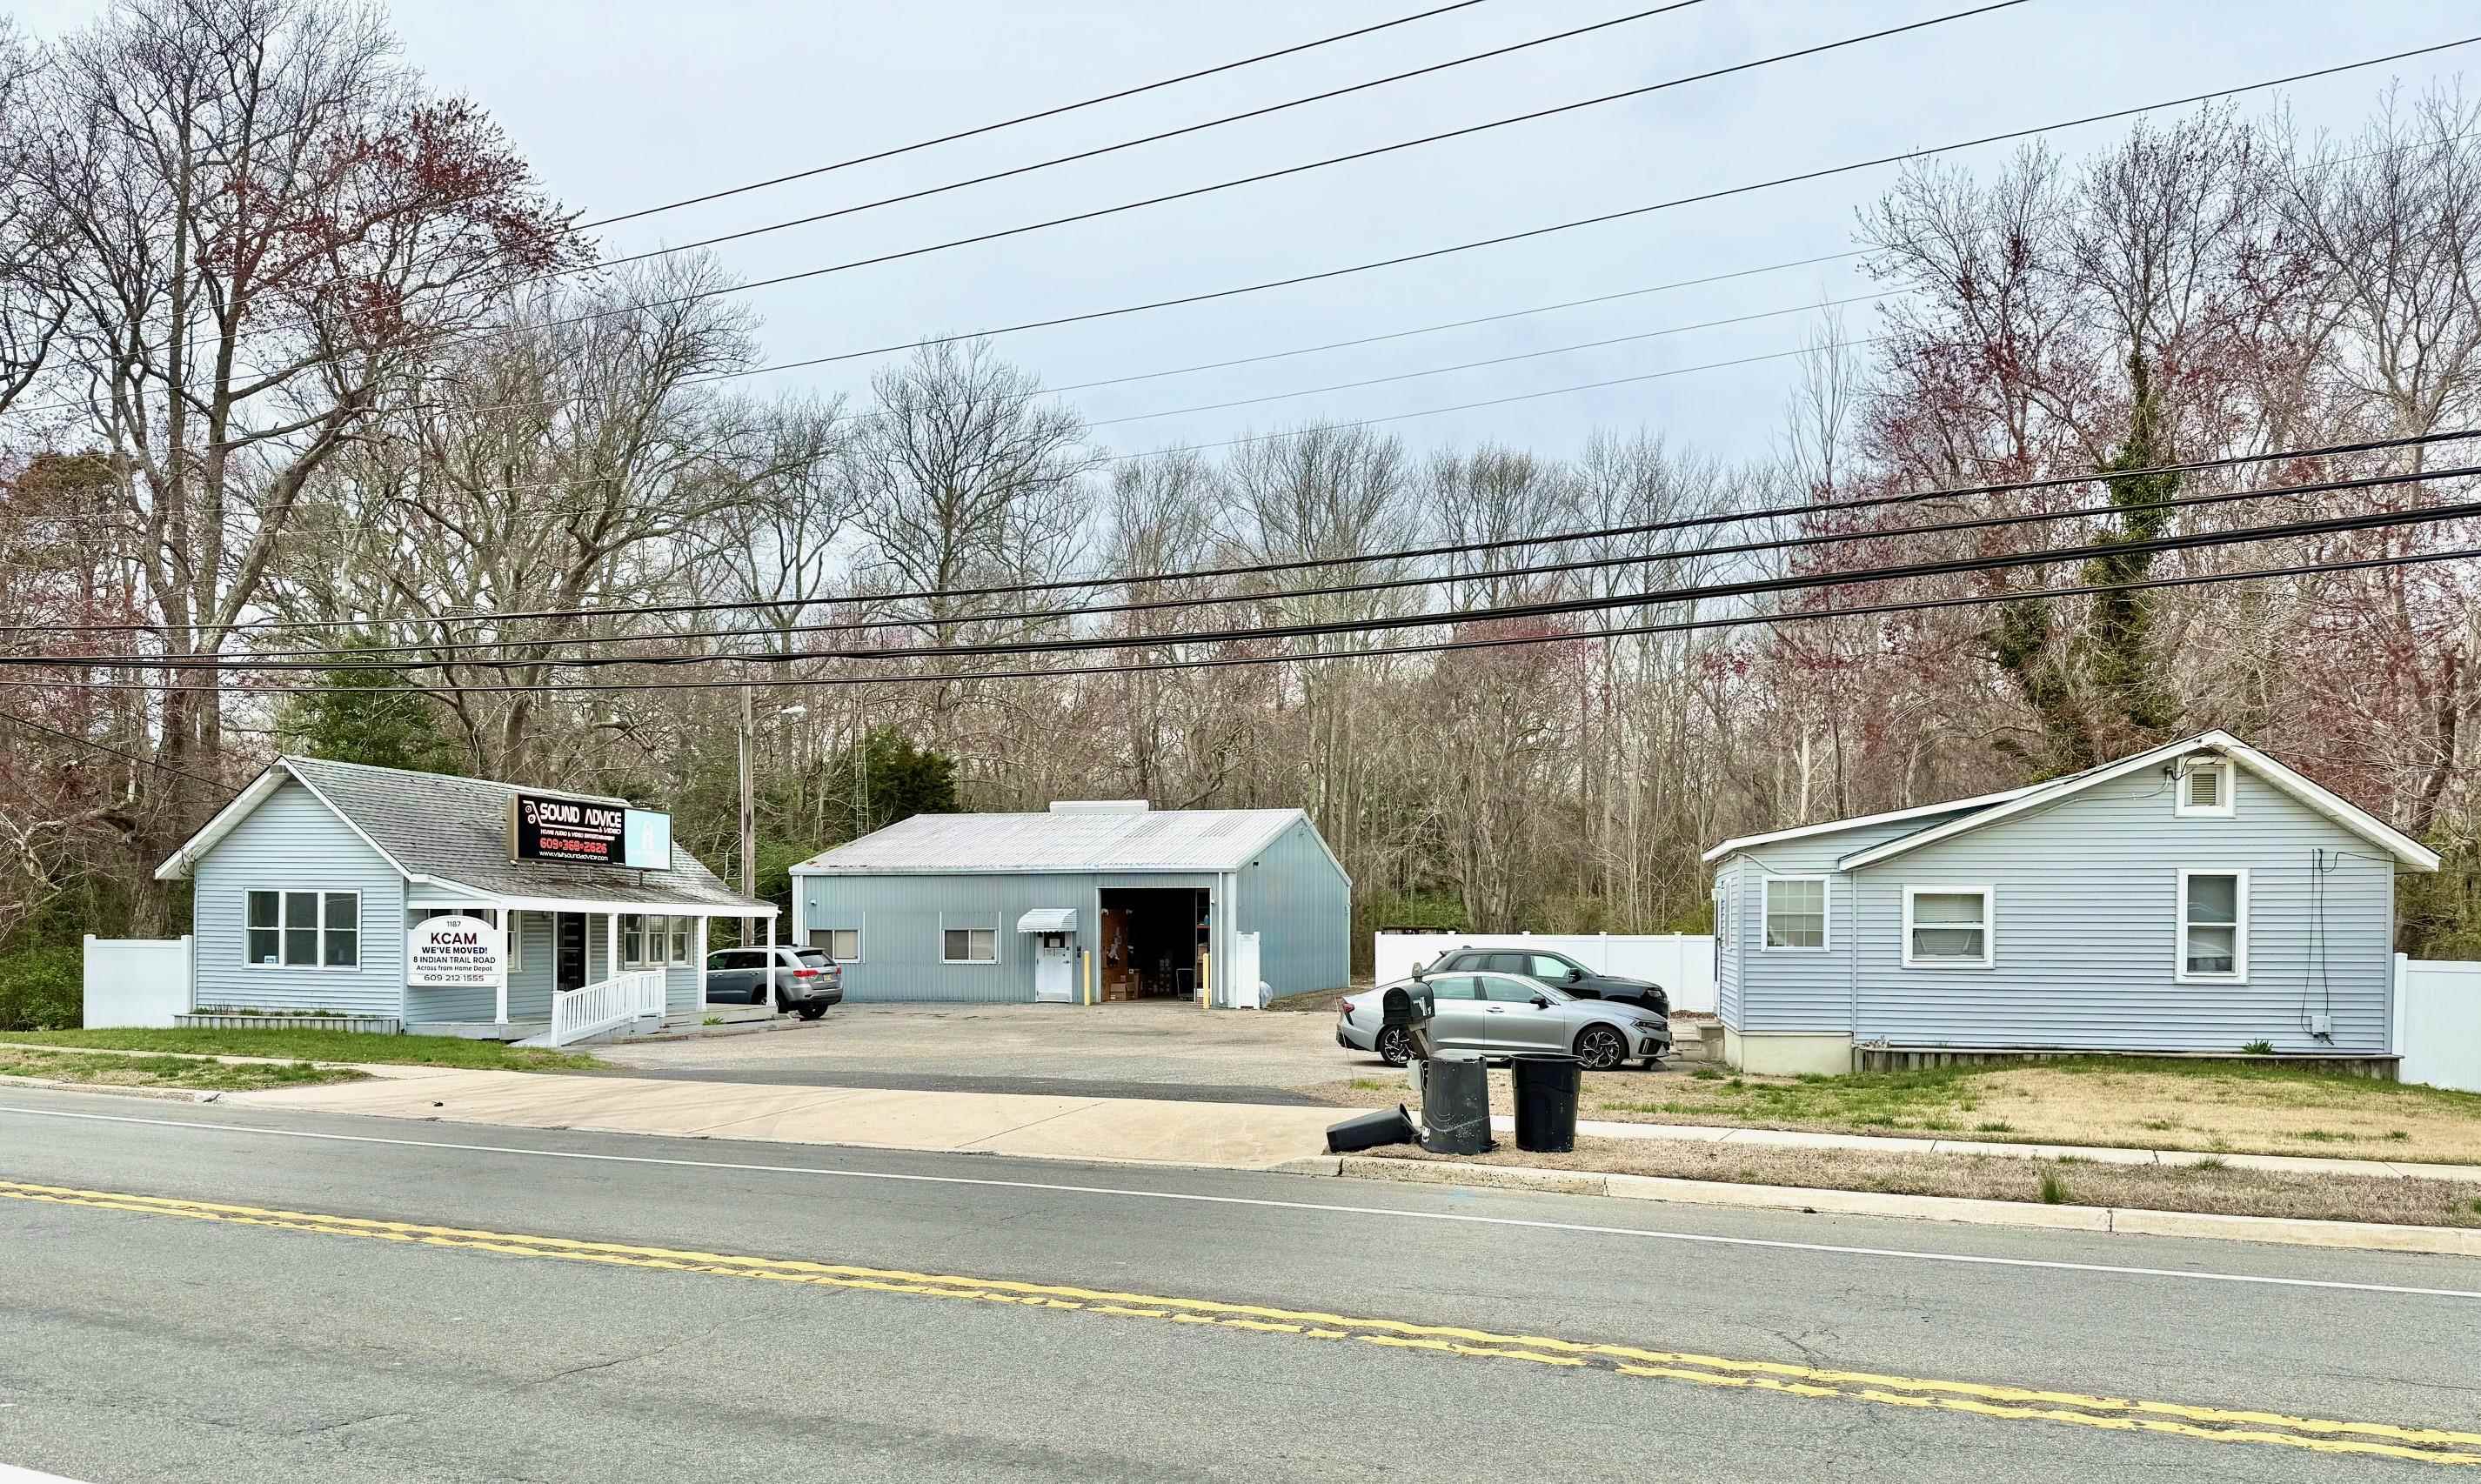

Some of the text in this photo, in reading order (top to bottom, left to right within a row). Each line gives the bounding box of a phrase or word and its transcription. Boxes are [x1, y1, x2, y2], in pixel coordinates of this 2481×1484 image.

[539, 802, 622, 828] SOUND ADVICE
[431, 933, 478, 945] KCAM
